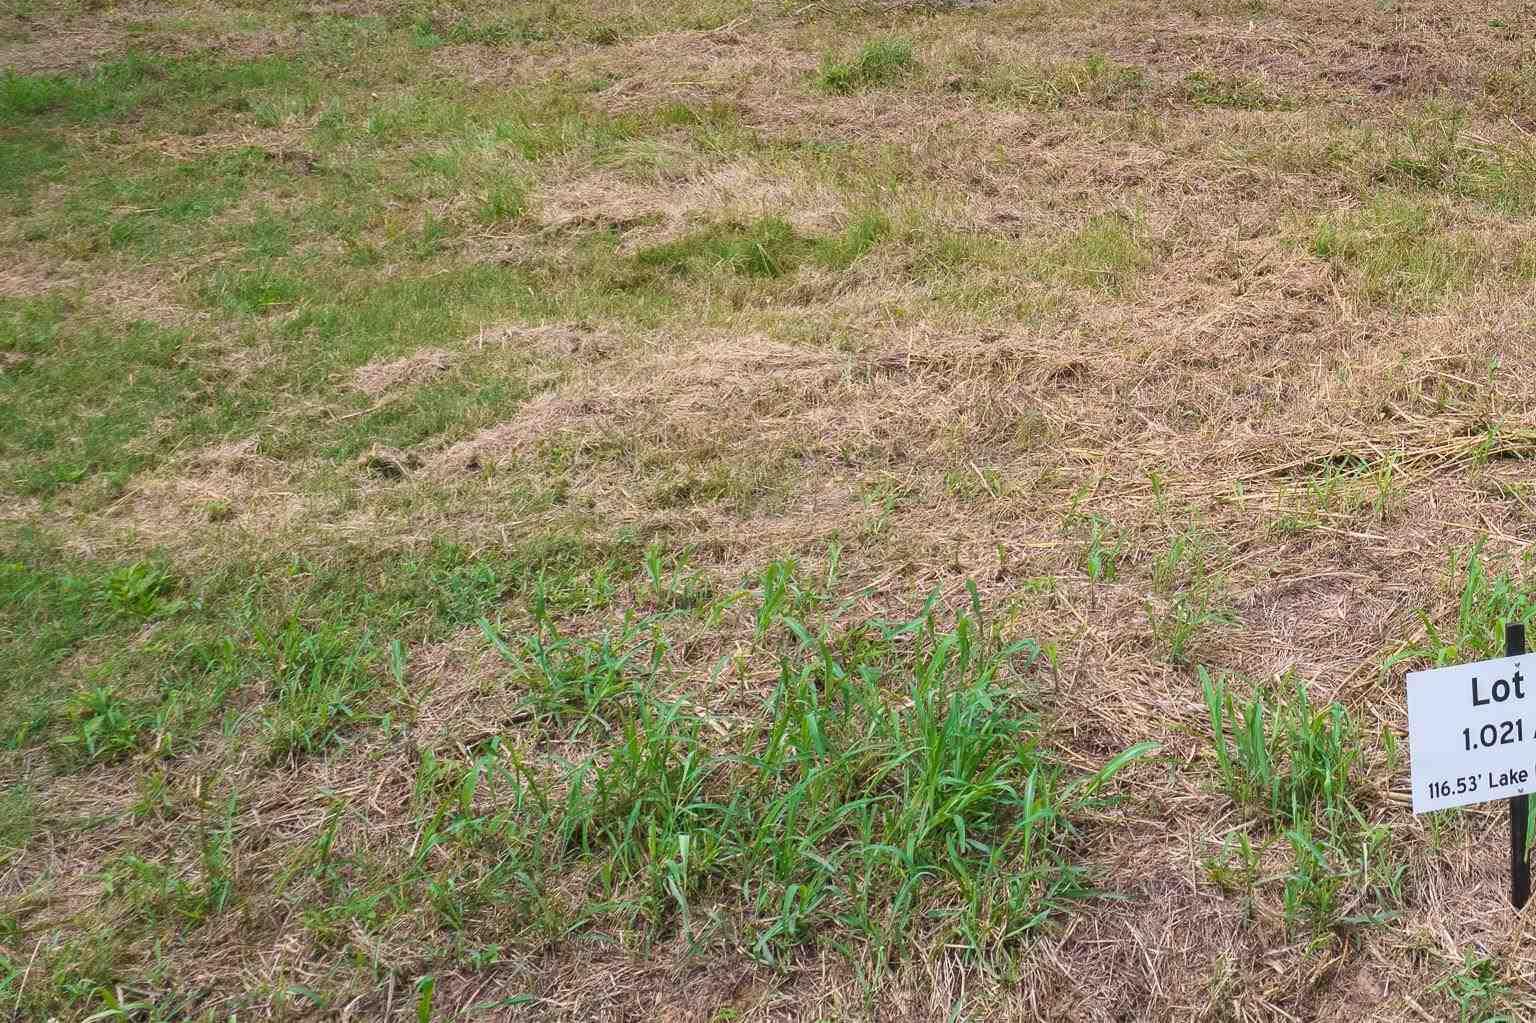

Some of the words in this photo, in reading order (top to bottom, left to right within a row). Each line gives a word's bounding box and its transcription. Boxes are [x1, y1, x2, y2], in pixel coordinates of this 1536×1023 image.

[1471, 670, 1526, 706] Lot
[1462, 718, 1524, 751] 1.021
[1428, 773, 1482, 799] 116.53'
[1488, 767, 1528, 789] Lake
